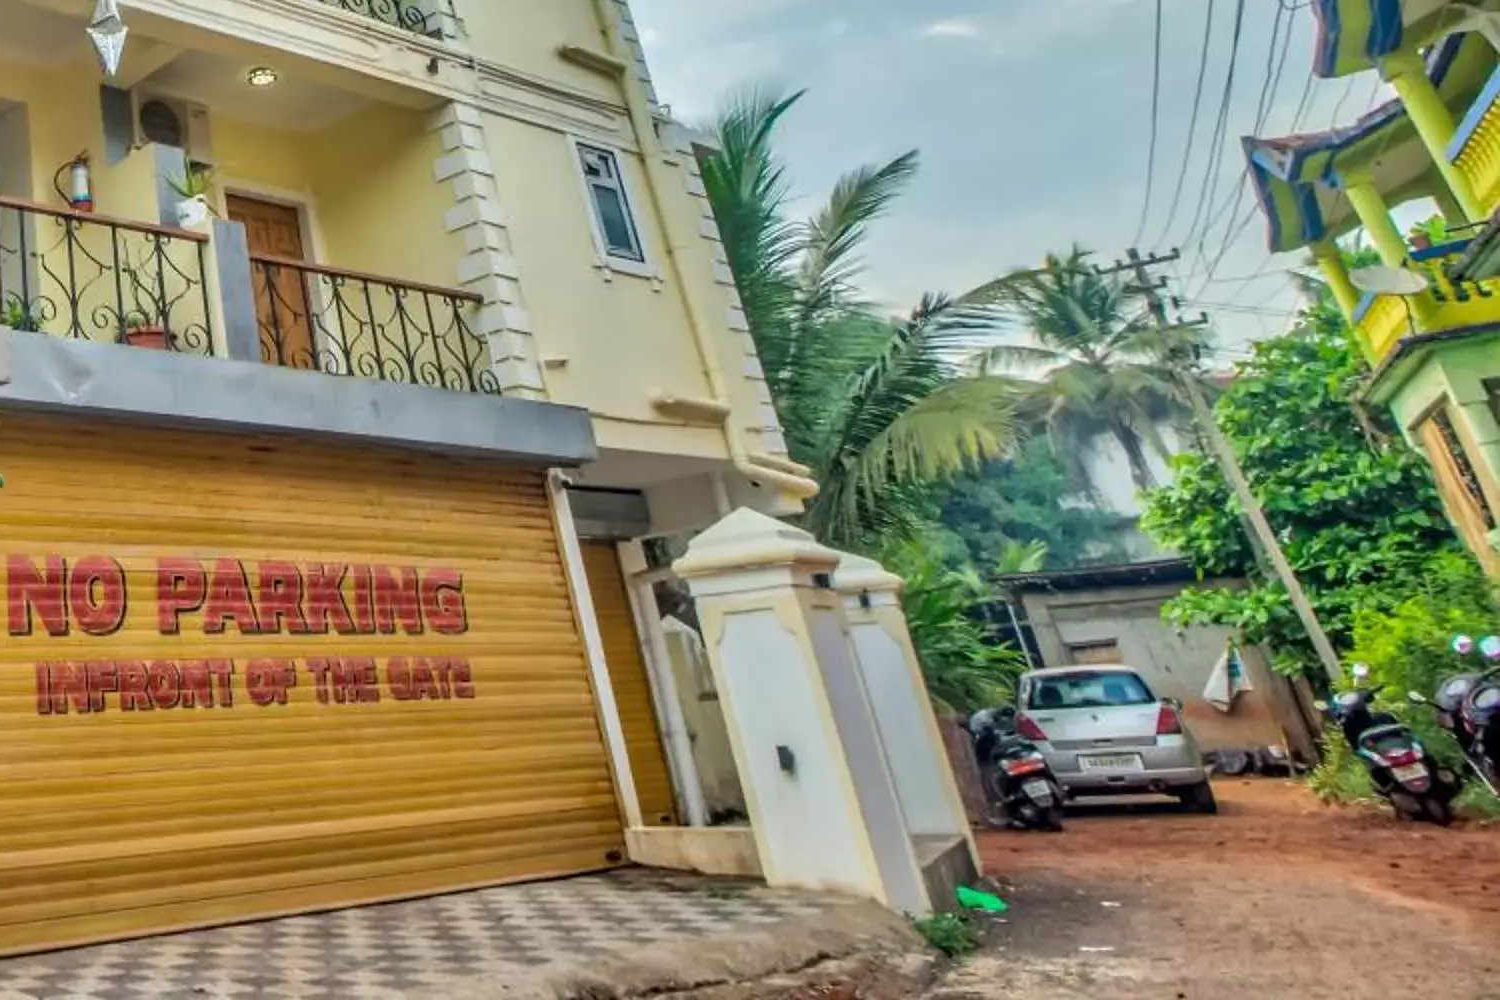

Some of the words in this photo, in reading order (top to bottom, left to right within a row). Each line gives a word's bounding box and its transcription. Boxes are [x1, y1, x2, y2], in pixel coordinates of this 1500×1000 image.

[7, 553, 127, 636] NO
[158, 556, 468, 634] PARKING
[36, 658, 235, 714] INFRONT
[245, 657, 296, 706] OF
[305, 656, 381, 704] THE
[387, 655, 475, 699] GATE
